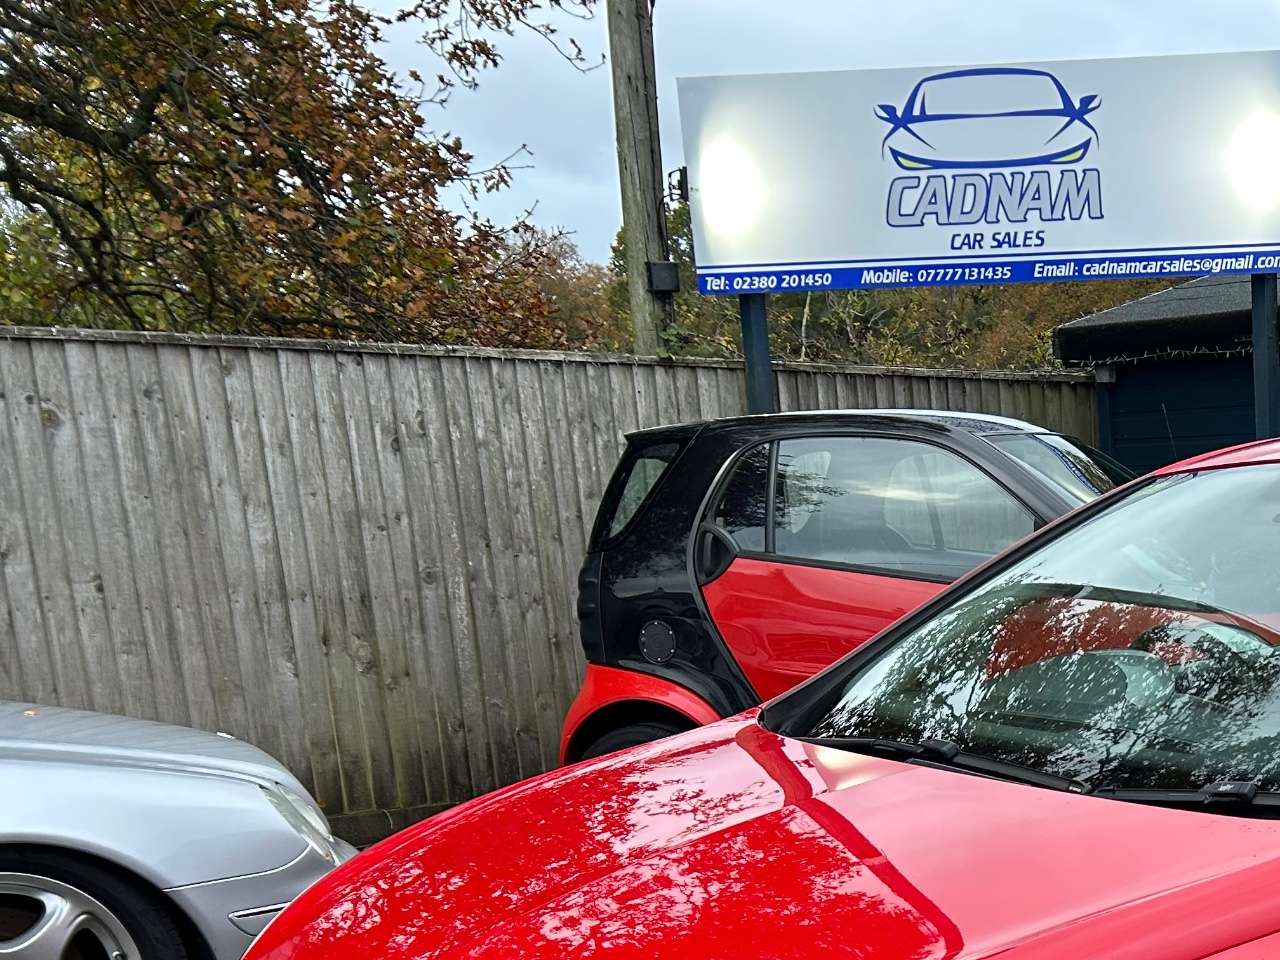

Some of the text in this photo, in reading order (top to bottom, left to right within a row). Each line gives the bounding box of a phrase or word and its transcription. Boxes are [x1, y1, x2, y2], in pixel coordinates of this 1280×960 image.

[886, 168, 1104, 228] CADNAM
[950, 230, 1045, 250] CAR SALES
[705, 276, 730, 290] Tel:
[733, 275, 777, 289] 02380
[781, 273, 832, 288] 201450
[861, 268, 913, 284] Mobile:
[917, 265, 1011, 282] 07777131435
[1034, 262, 1079, 278] Email:
